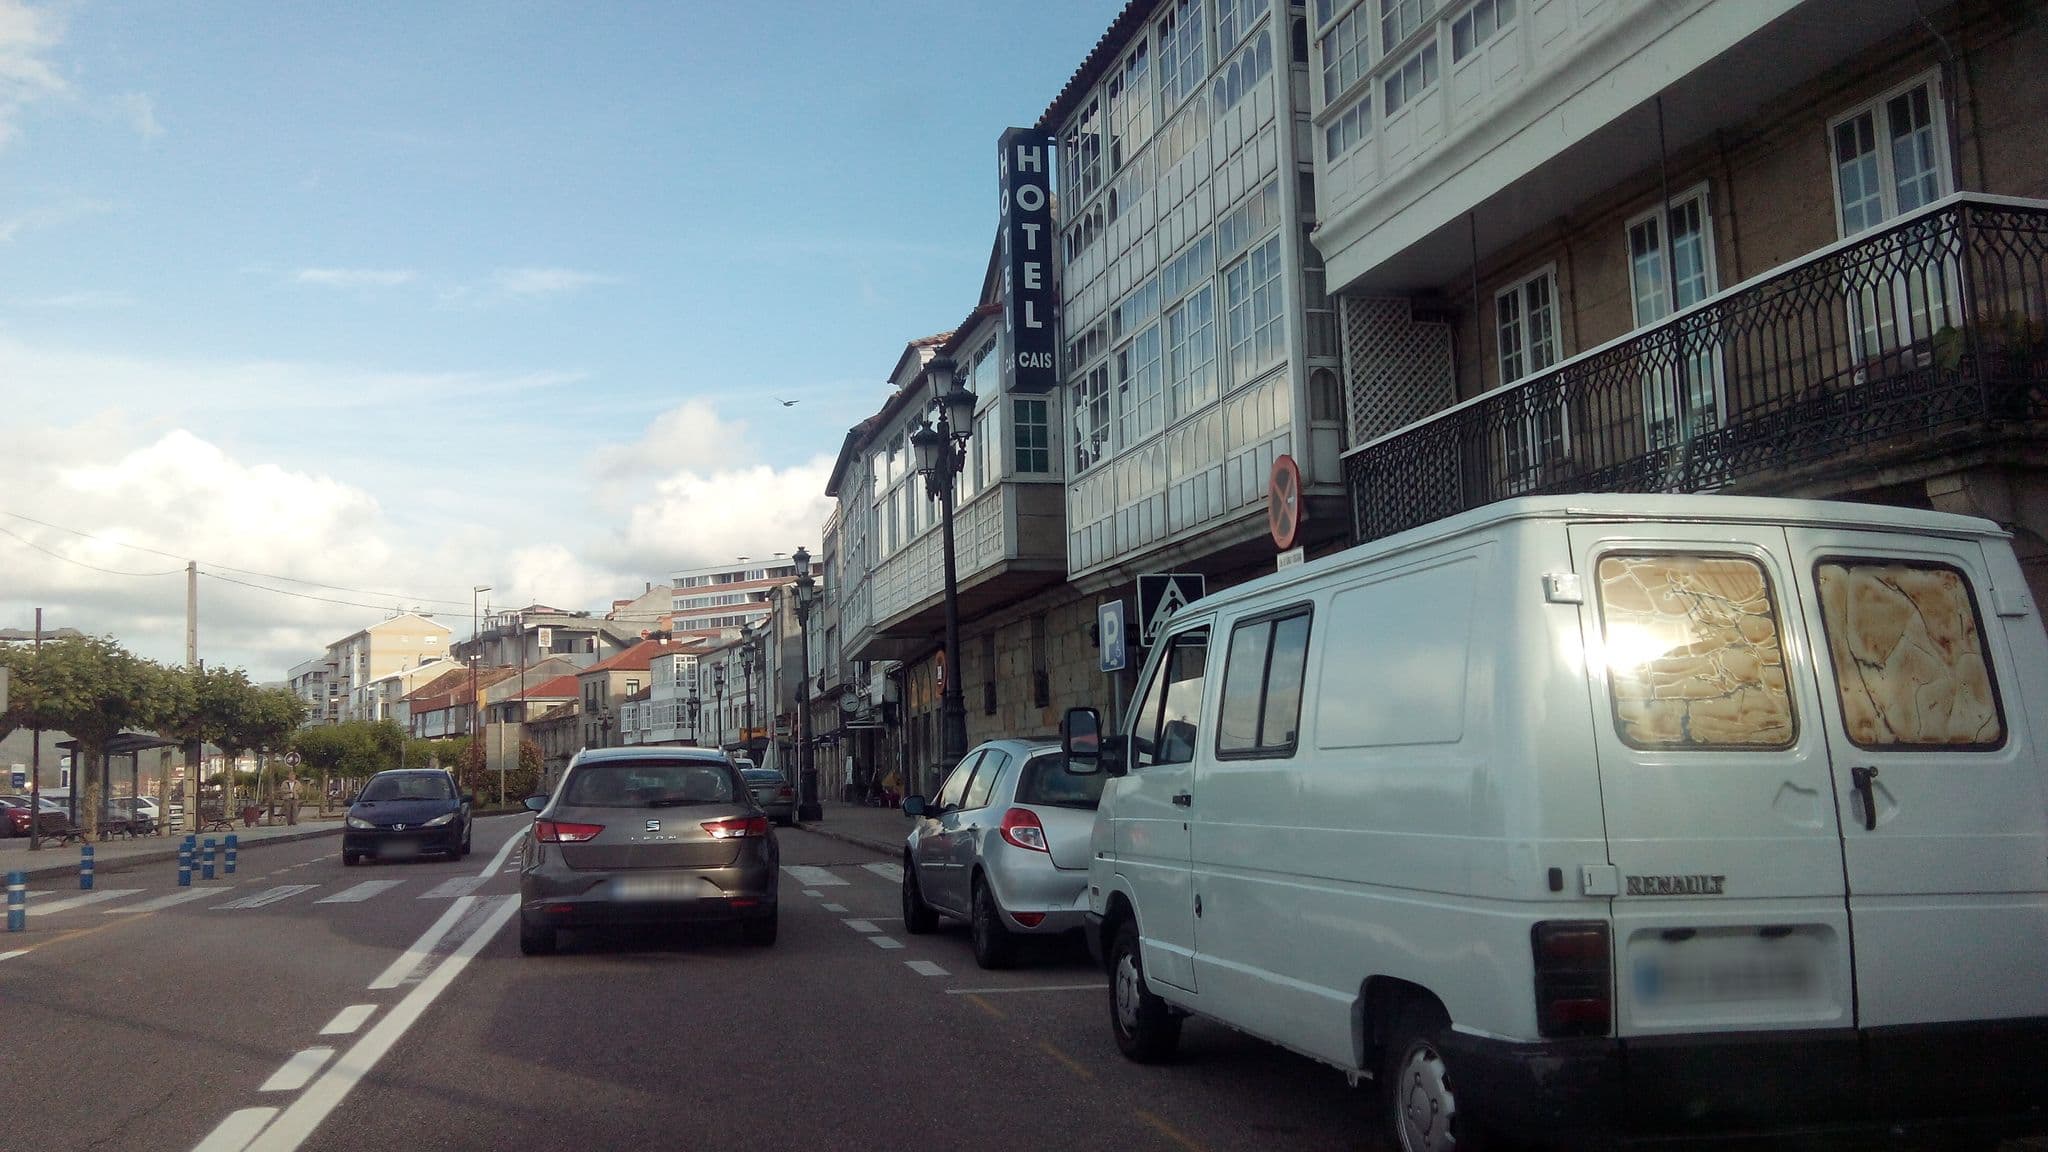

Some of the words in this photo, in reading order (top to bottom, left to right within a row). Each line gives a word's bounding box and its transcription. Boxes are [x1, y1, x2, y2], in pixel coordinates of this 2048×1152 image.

[1000, 148, 1012, 334] HOTEL
[1016, 145, 1046, 329] HOTEL
[1018, 351, 1053, 369] CAIS
[1103, 611, 1119, 663] P
[1626, 875, 1725, 895] RENAULT
